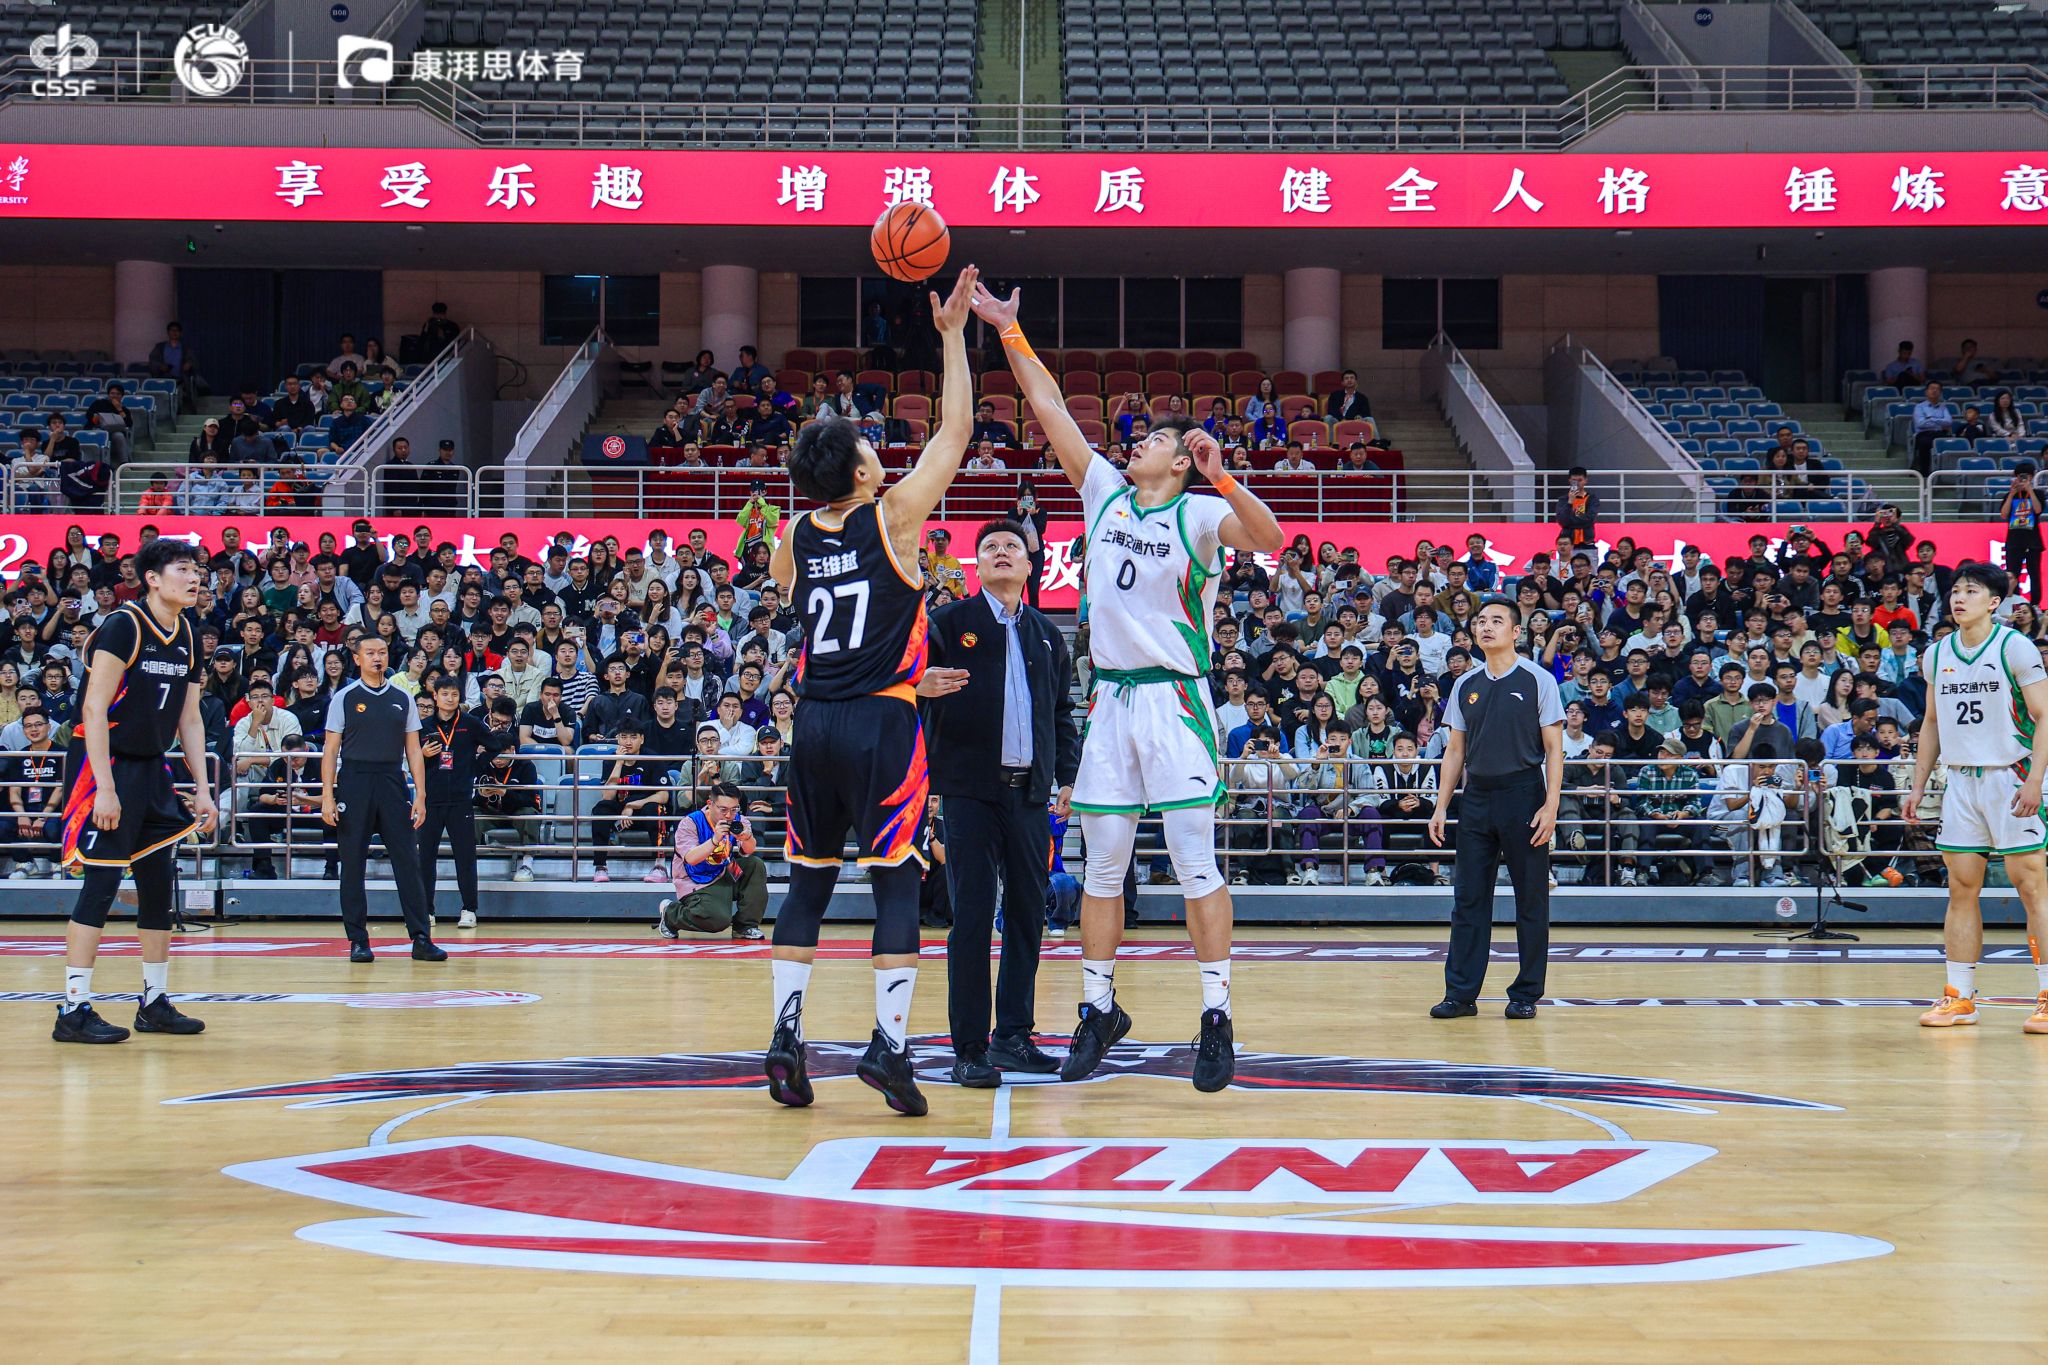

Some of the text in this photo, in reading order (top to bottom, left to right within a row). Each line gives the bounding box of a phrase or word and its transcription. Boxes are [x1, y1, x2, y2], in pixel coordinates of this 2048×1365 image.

[1101, 528, 1171, 558] 上海交通大学
[807, 550, 859, 579] 王维越
[1116, 559, 1136, 591] 0
[807, 580, 870, 655] 27
[159, 683, 171, 710] 7
[1940, 681, 2000, 695] 上海交通大学
[1956, 700, 1984, 725] 25
[86, 831, 98, 850] 7
[851, 1145, 1650, 1193] ANTA
